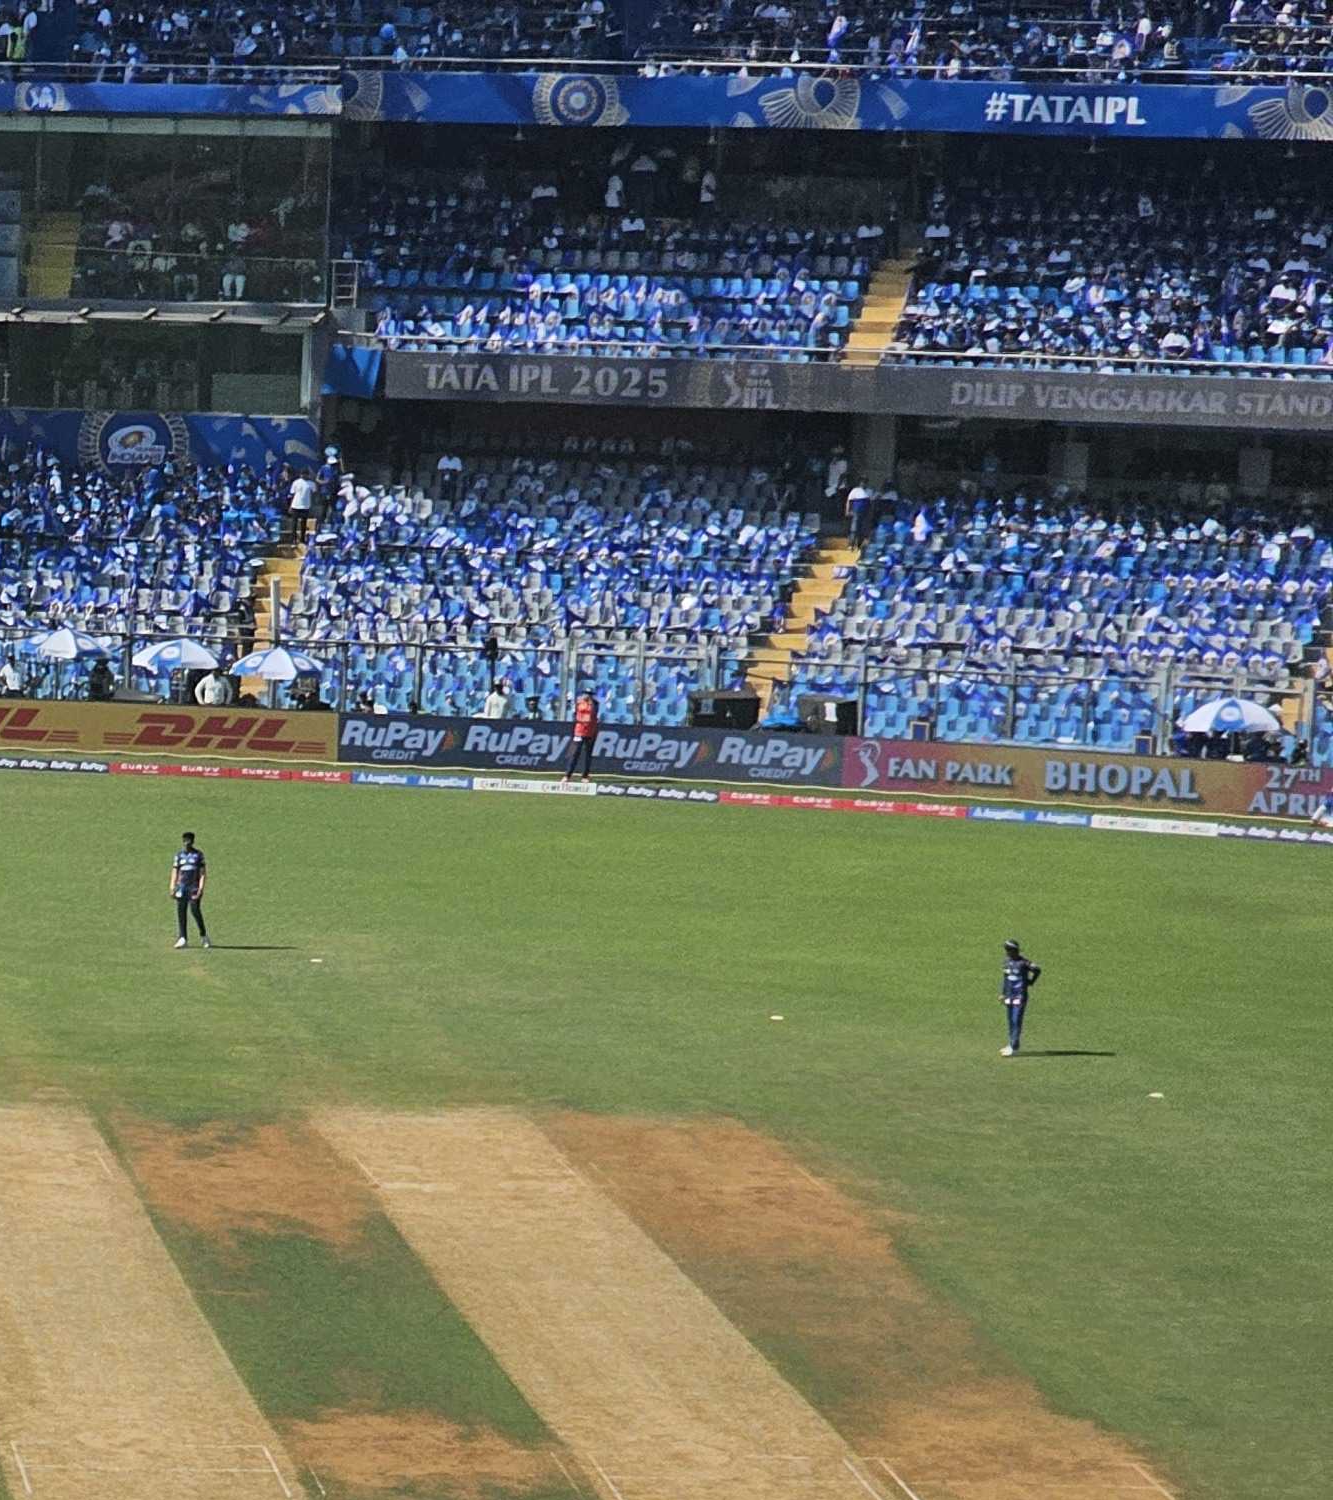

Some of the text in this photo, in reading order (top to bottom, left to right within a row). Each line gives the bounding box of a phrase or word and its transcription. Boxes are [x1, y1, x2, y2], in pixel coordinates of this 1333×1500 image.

[985, 92, 1146, 125] #TATAIPL
[424, 364, 668, 398] TATA IPL 2025
[950, 382, 1332, 417] DILIP VENGSARKAR STAND
[133, 711, 297, 755] DHL
[341, 719, 446, 757] RuPay
[464, 724, 572, 760] RuPay
[592, 730, 699, 768] RuPay
[372, 749, 418, 761] CREDIT
[495, 753, 542, 767] CREDIT
[623, 759, 670, 774] CREDIT
[717, 736, 826, 775] RuPay
[887, 757, 1014, 787] FAN PARK
[750, 765, 795, 780] CREDIT
[1044, 760, 1201, 801] BHOPAL
[1265, 765, 1321, 790] 27TH
